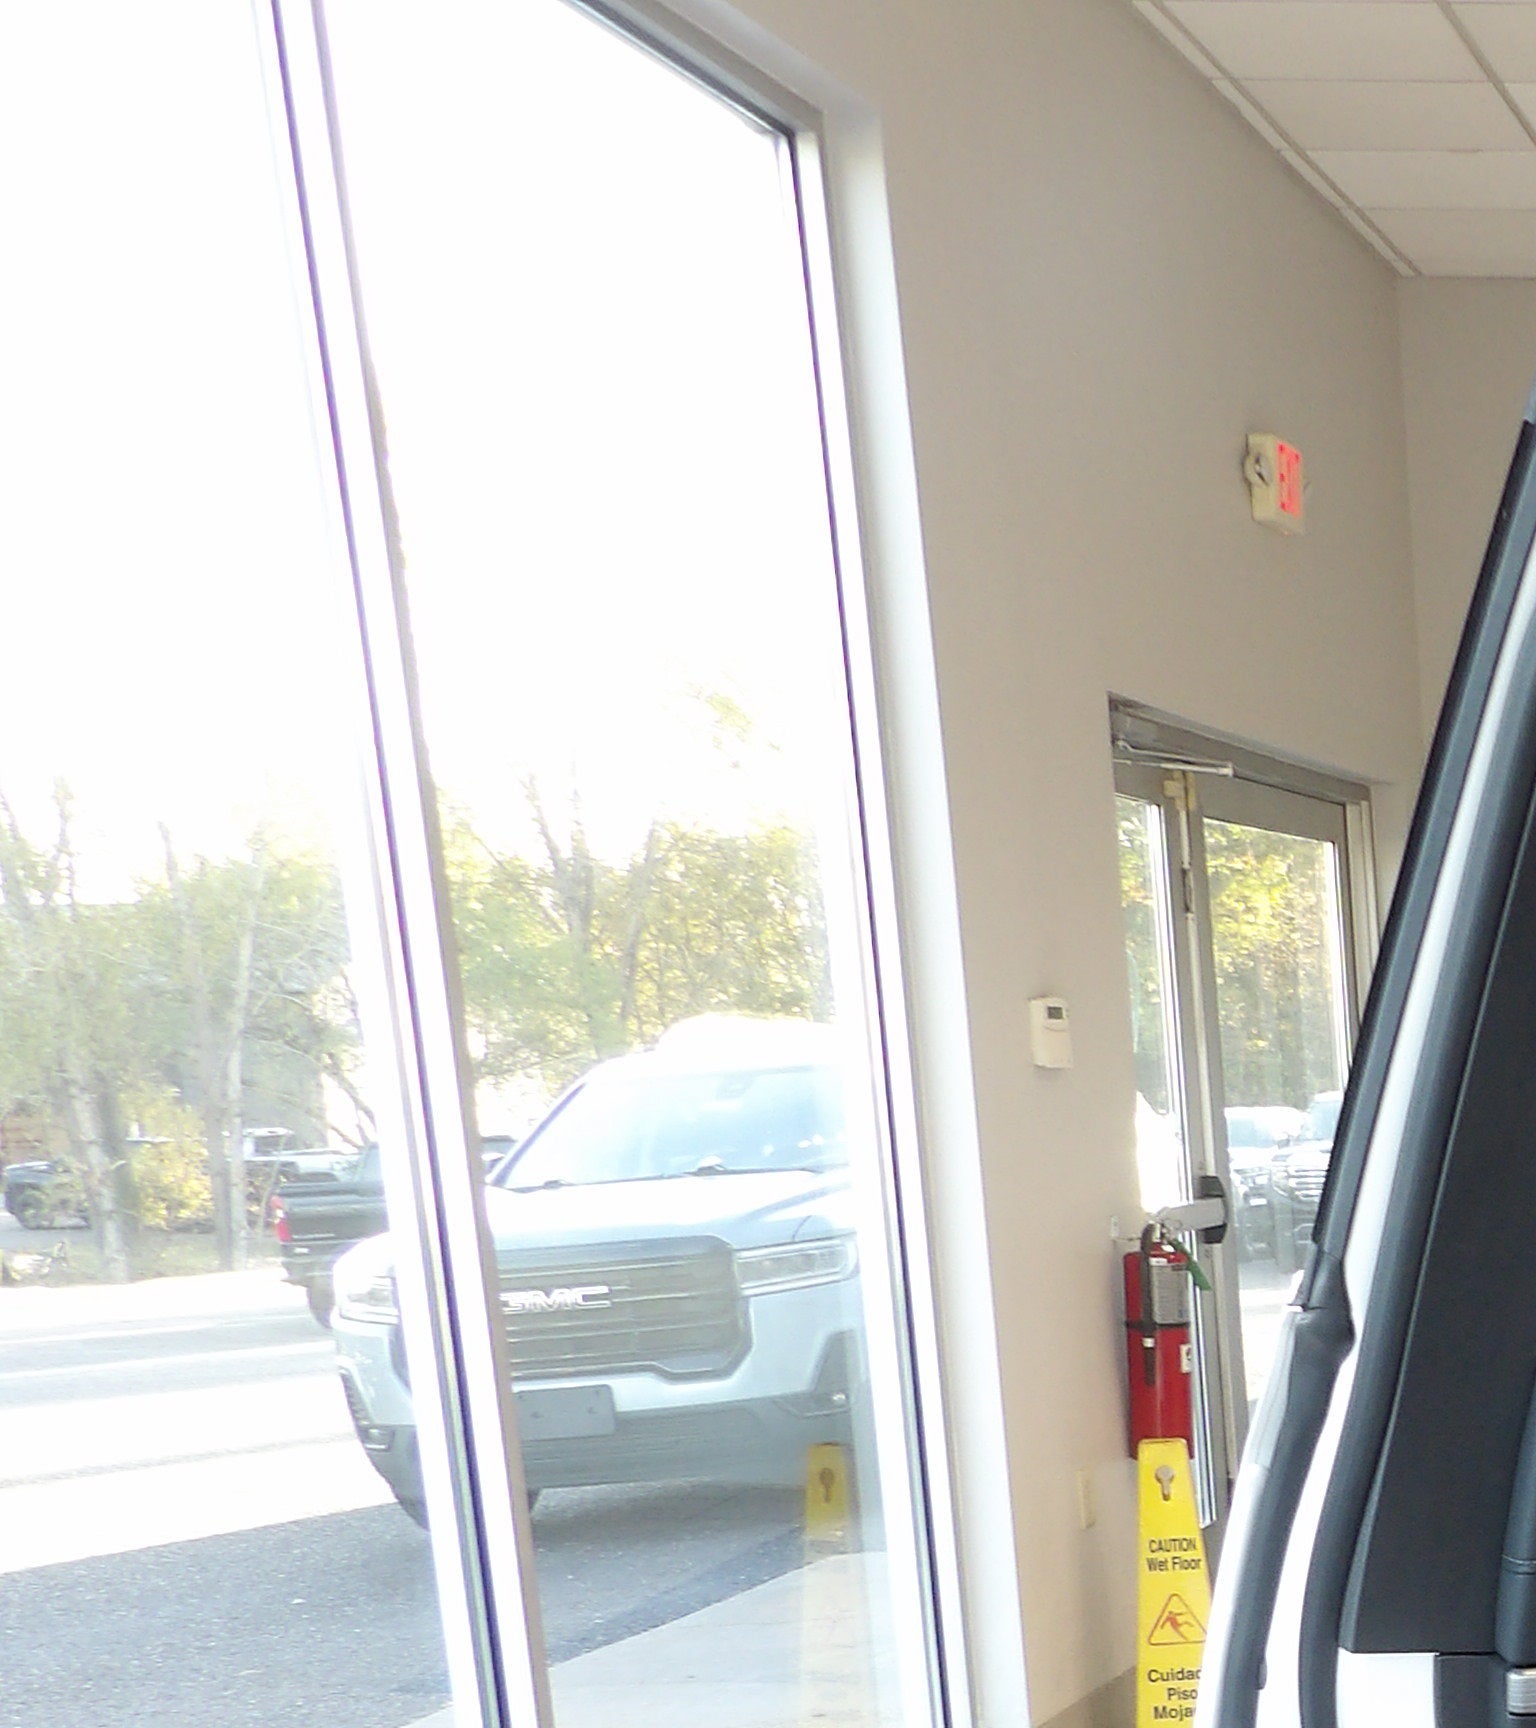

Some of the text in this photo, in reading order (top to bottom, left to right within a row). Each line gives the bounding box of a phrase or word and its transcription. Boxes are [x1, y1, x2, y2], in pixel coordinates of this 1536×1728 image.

[1149, 1538, 1197, 1553] CAUTION
[1147, 1556, 1201, 1572] Wet Floor
[1167, 1687, 1198, 1701] Piso
